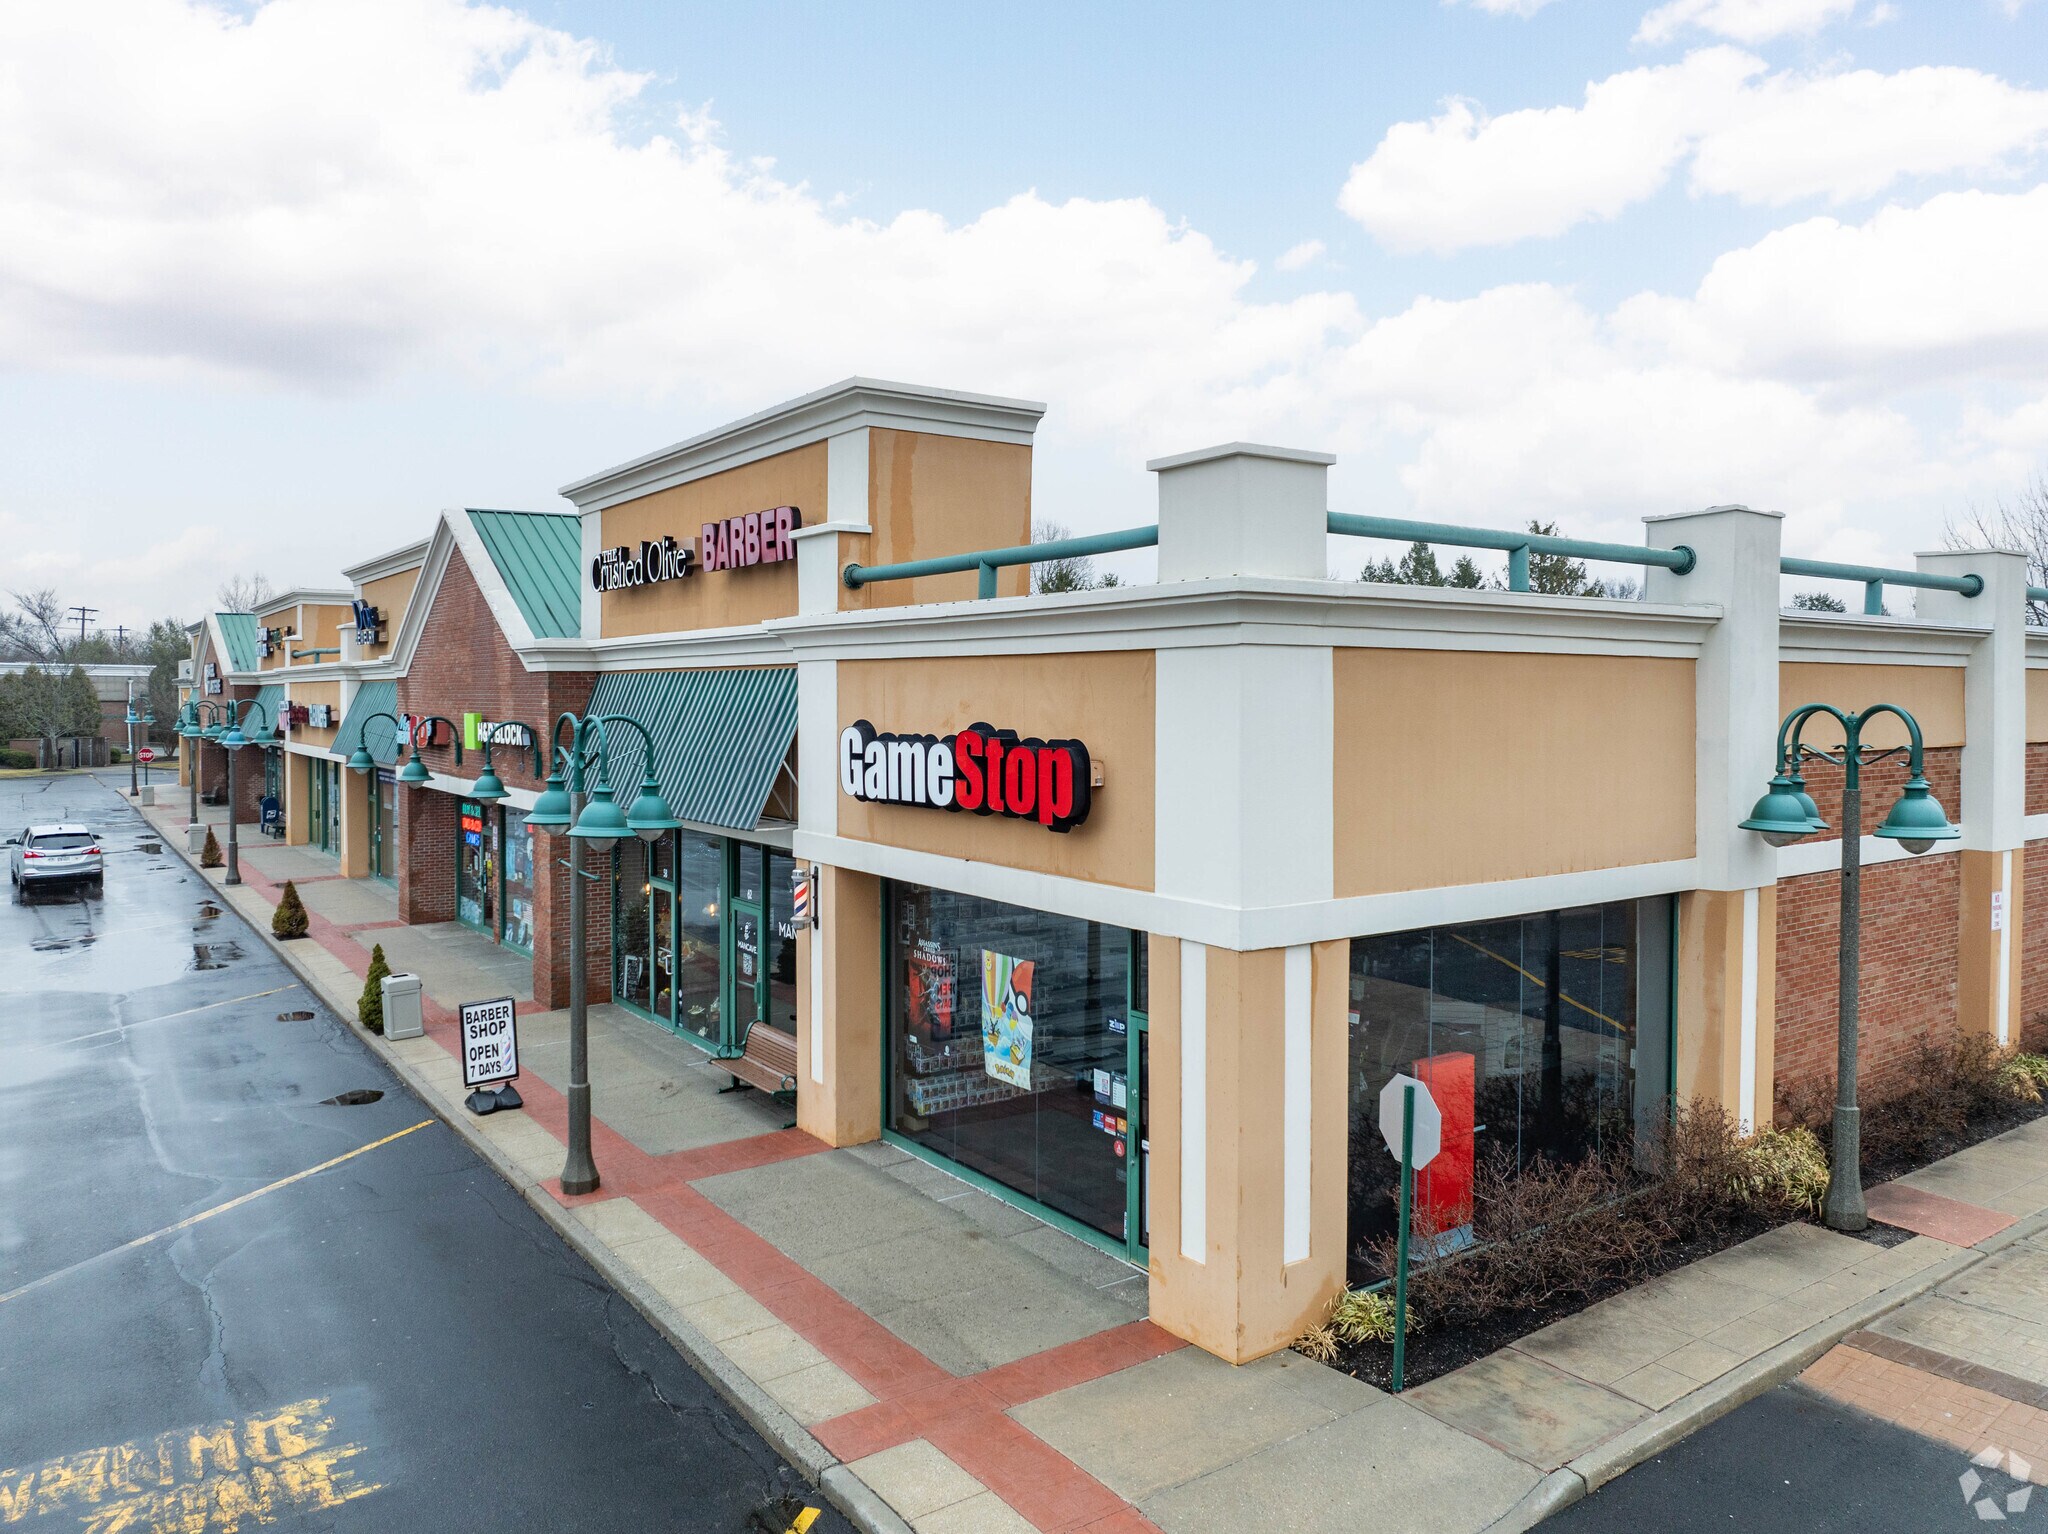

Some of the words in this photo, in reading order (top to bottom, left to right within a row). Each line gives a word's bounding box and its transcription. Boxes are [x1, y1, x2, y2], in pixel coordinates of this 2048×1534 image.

[702, 506, 795, 573] BARBER
[591, 541, 644, 593] Crushed
[647, 537, 687, 583] Olive
[602, 548, 617, 564] THE
[494, 723, 523, 746] BLOCK
[840, 725, 1074, 825] GameStop
[913, 949, 946, 966] SHADOWS
[466, 1006, 509, 1024] BARBER
[470, 1021, 506, 1039] SHOP
[470, 1043, 499, 1061] OPEN
[470, 1065, 475, 1077] 7
[479, 1061, 501, 1076] DAYS
